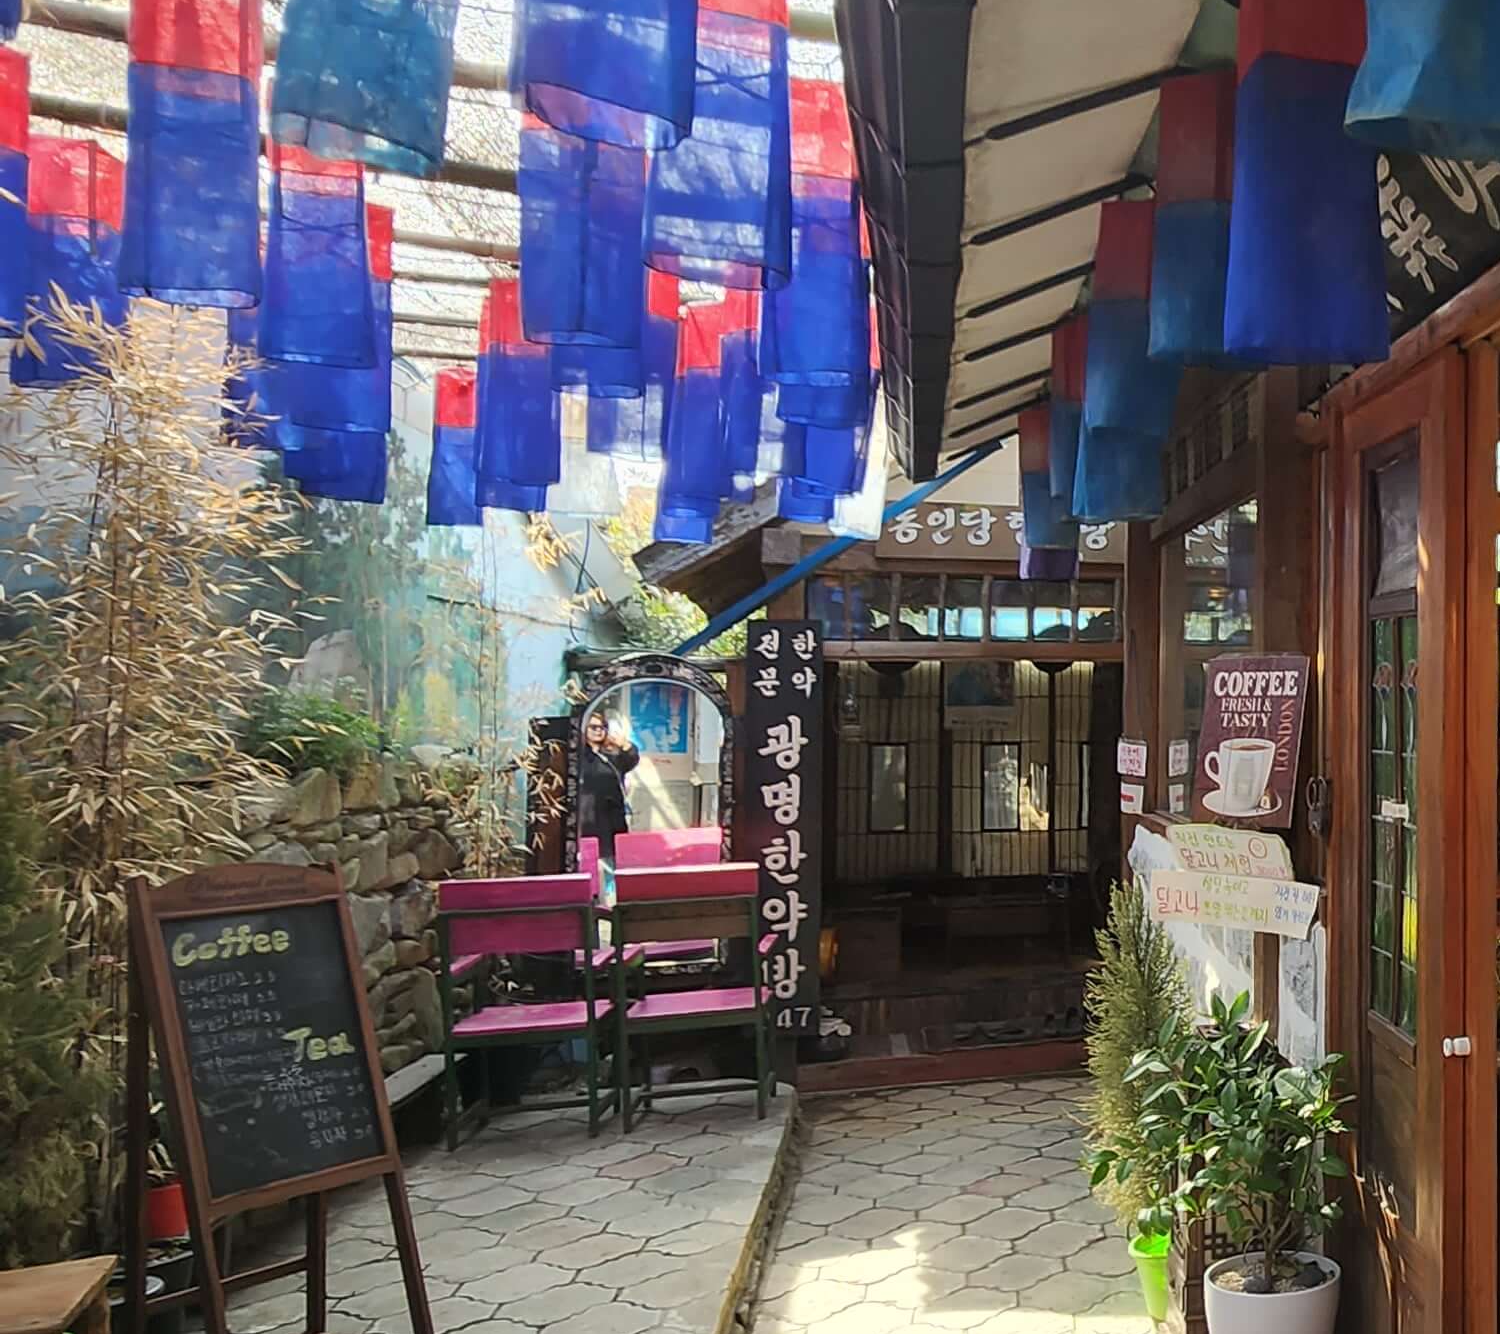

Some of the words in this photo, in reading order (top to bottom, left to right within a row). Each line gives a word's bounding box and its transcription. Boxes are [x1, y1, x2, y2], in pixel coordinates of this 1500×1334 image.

[1214, 670, 1299, 697] COFFEE
[1220, 698, 1262, 712] FRESH
[1263, 698, 1273, 712] &
[1220, 712, 1272, 728] TASTY
[1273, 698, 1295, 772] LONDON
[757, 715, 809, 999] 광명한약방
[171, 923, 291, 967] Coffee
[281, 1026, 356, 1063] Tea
